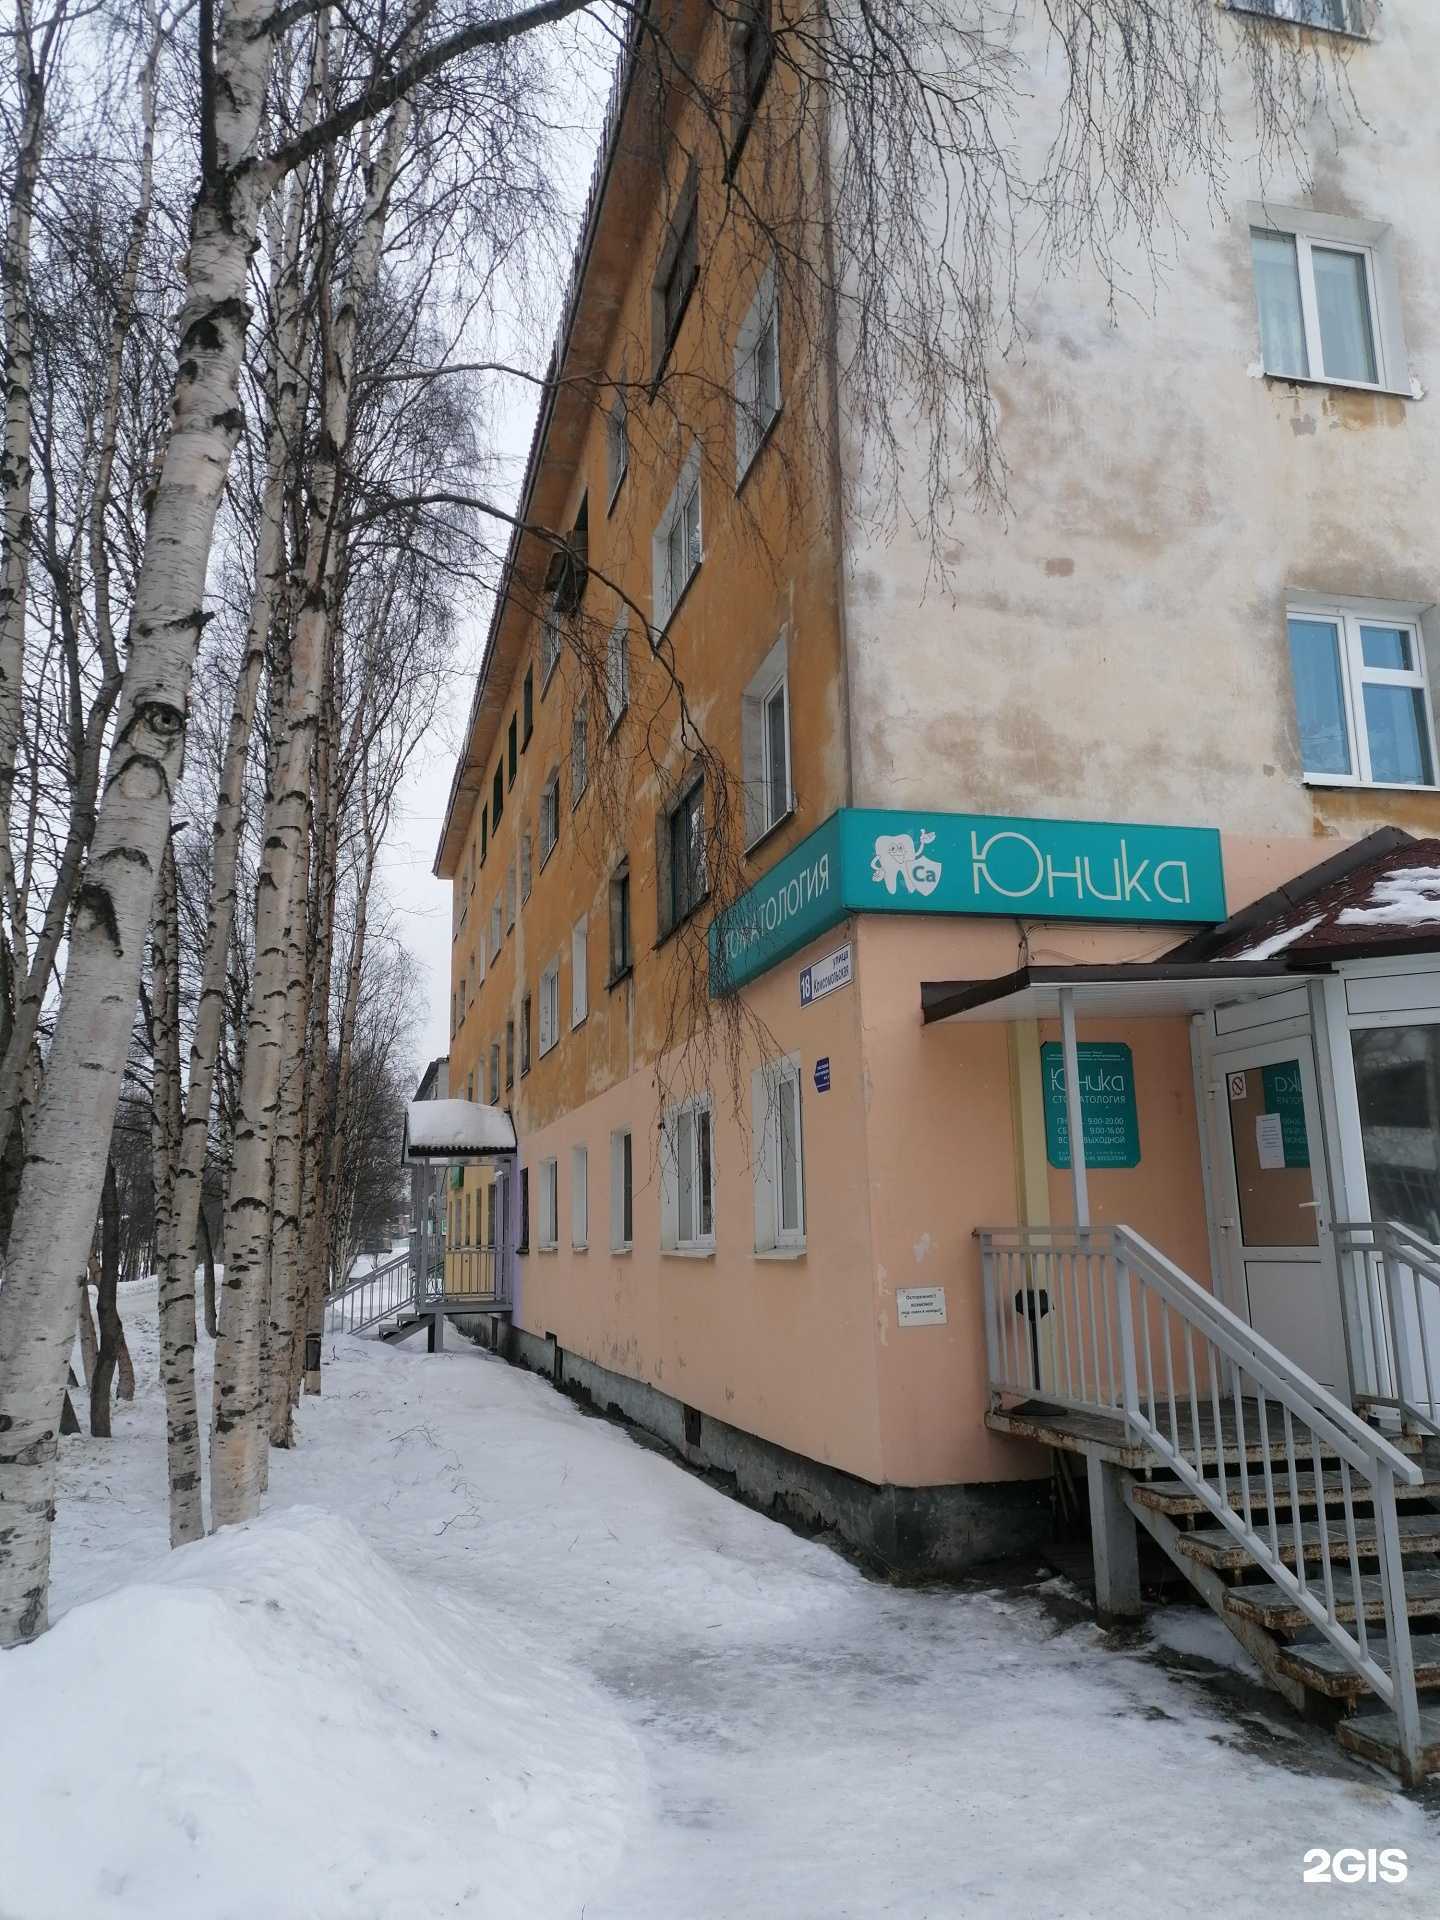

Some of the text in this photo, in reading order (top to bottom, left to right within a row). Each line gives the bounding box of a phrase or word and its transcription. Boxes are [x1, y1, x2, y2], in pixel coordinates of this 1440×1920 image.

[912, 865, 936, 882] Ca
[971, 831, 1191, 904] Юника
[801, 975, 811, 999] 18
